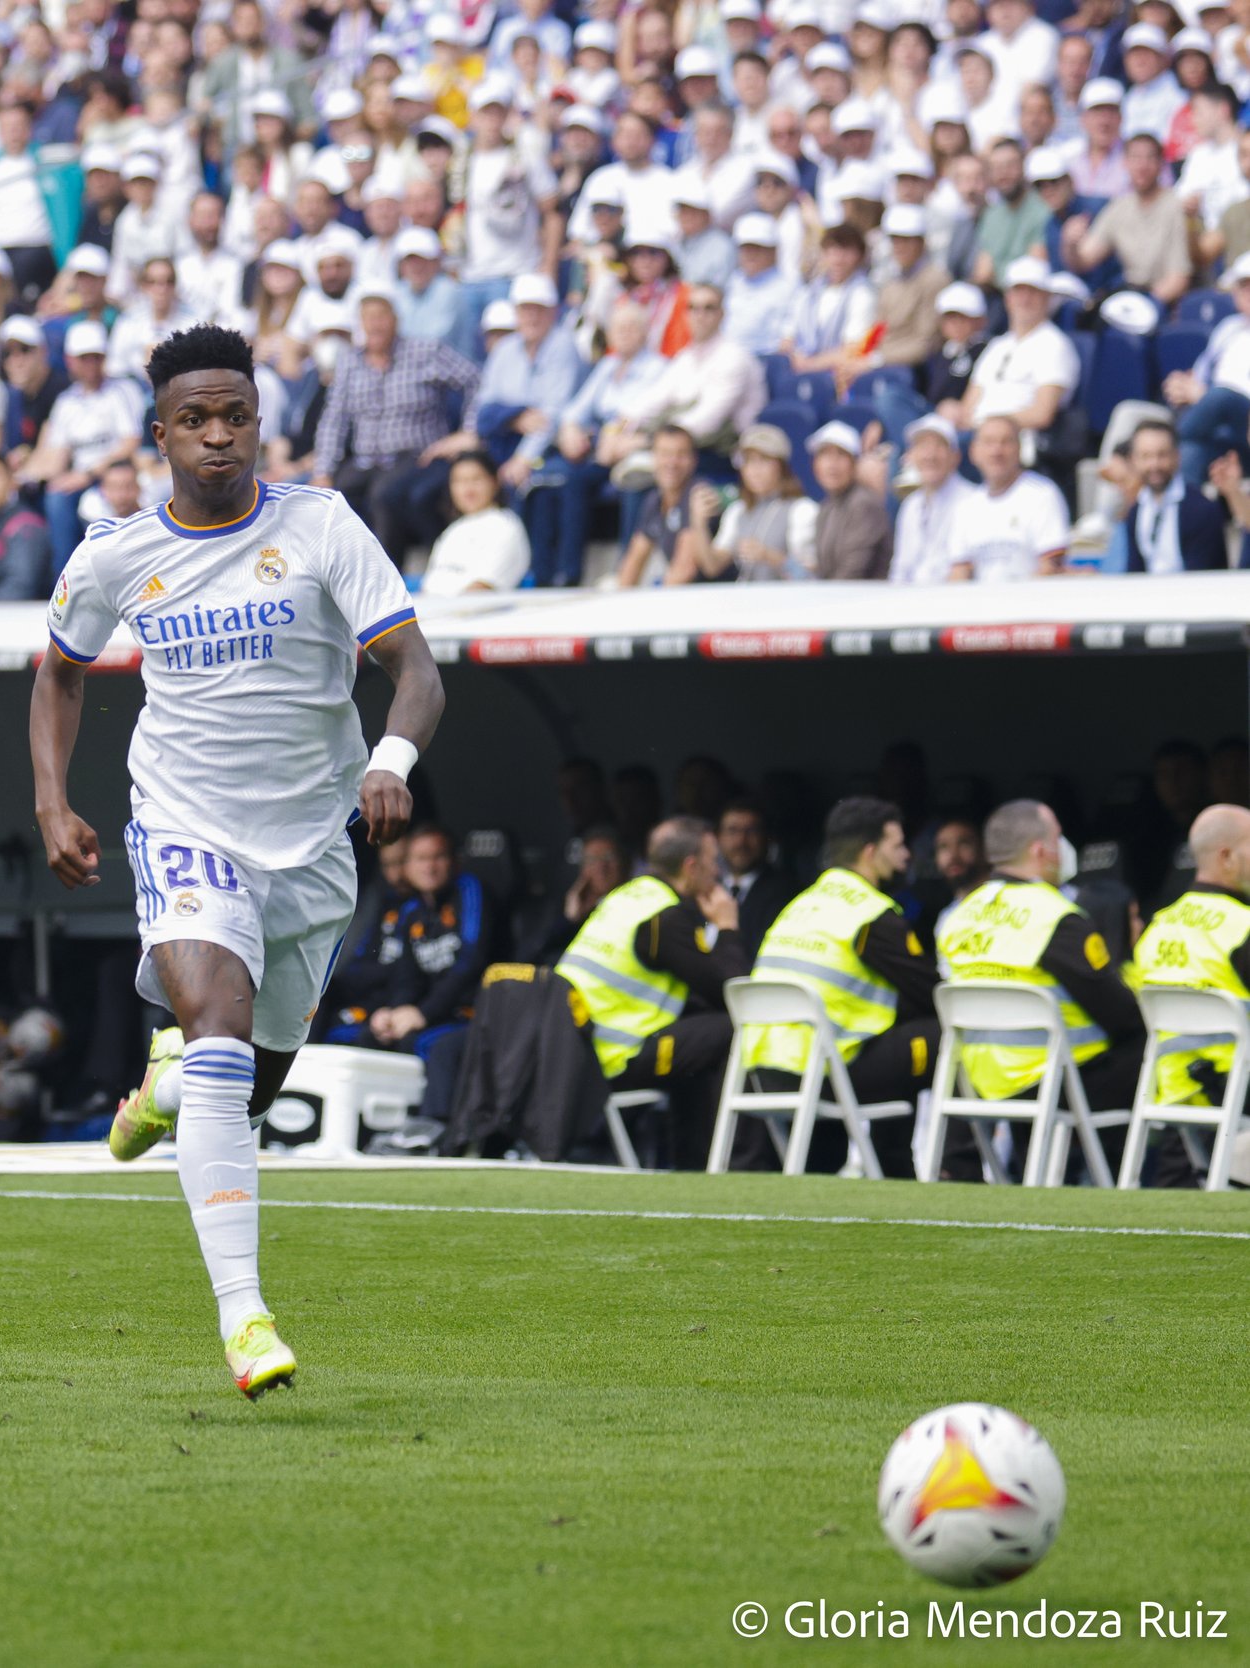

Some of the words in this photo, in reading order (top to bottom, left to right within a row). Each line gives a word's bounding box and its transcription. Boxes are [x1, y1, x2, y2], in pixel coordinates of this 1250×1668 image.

[138, 590, 169, 602] adidas
[136, 599, 295, 645] Emirates
[164, 644, 193, 670] FLY
[203, 633, 273, 667] BETTER
[158, 844, 238, 893] 20
